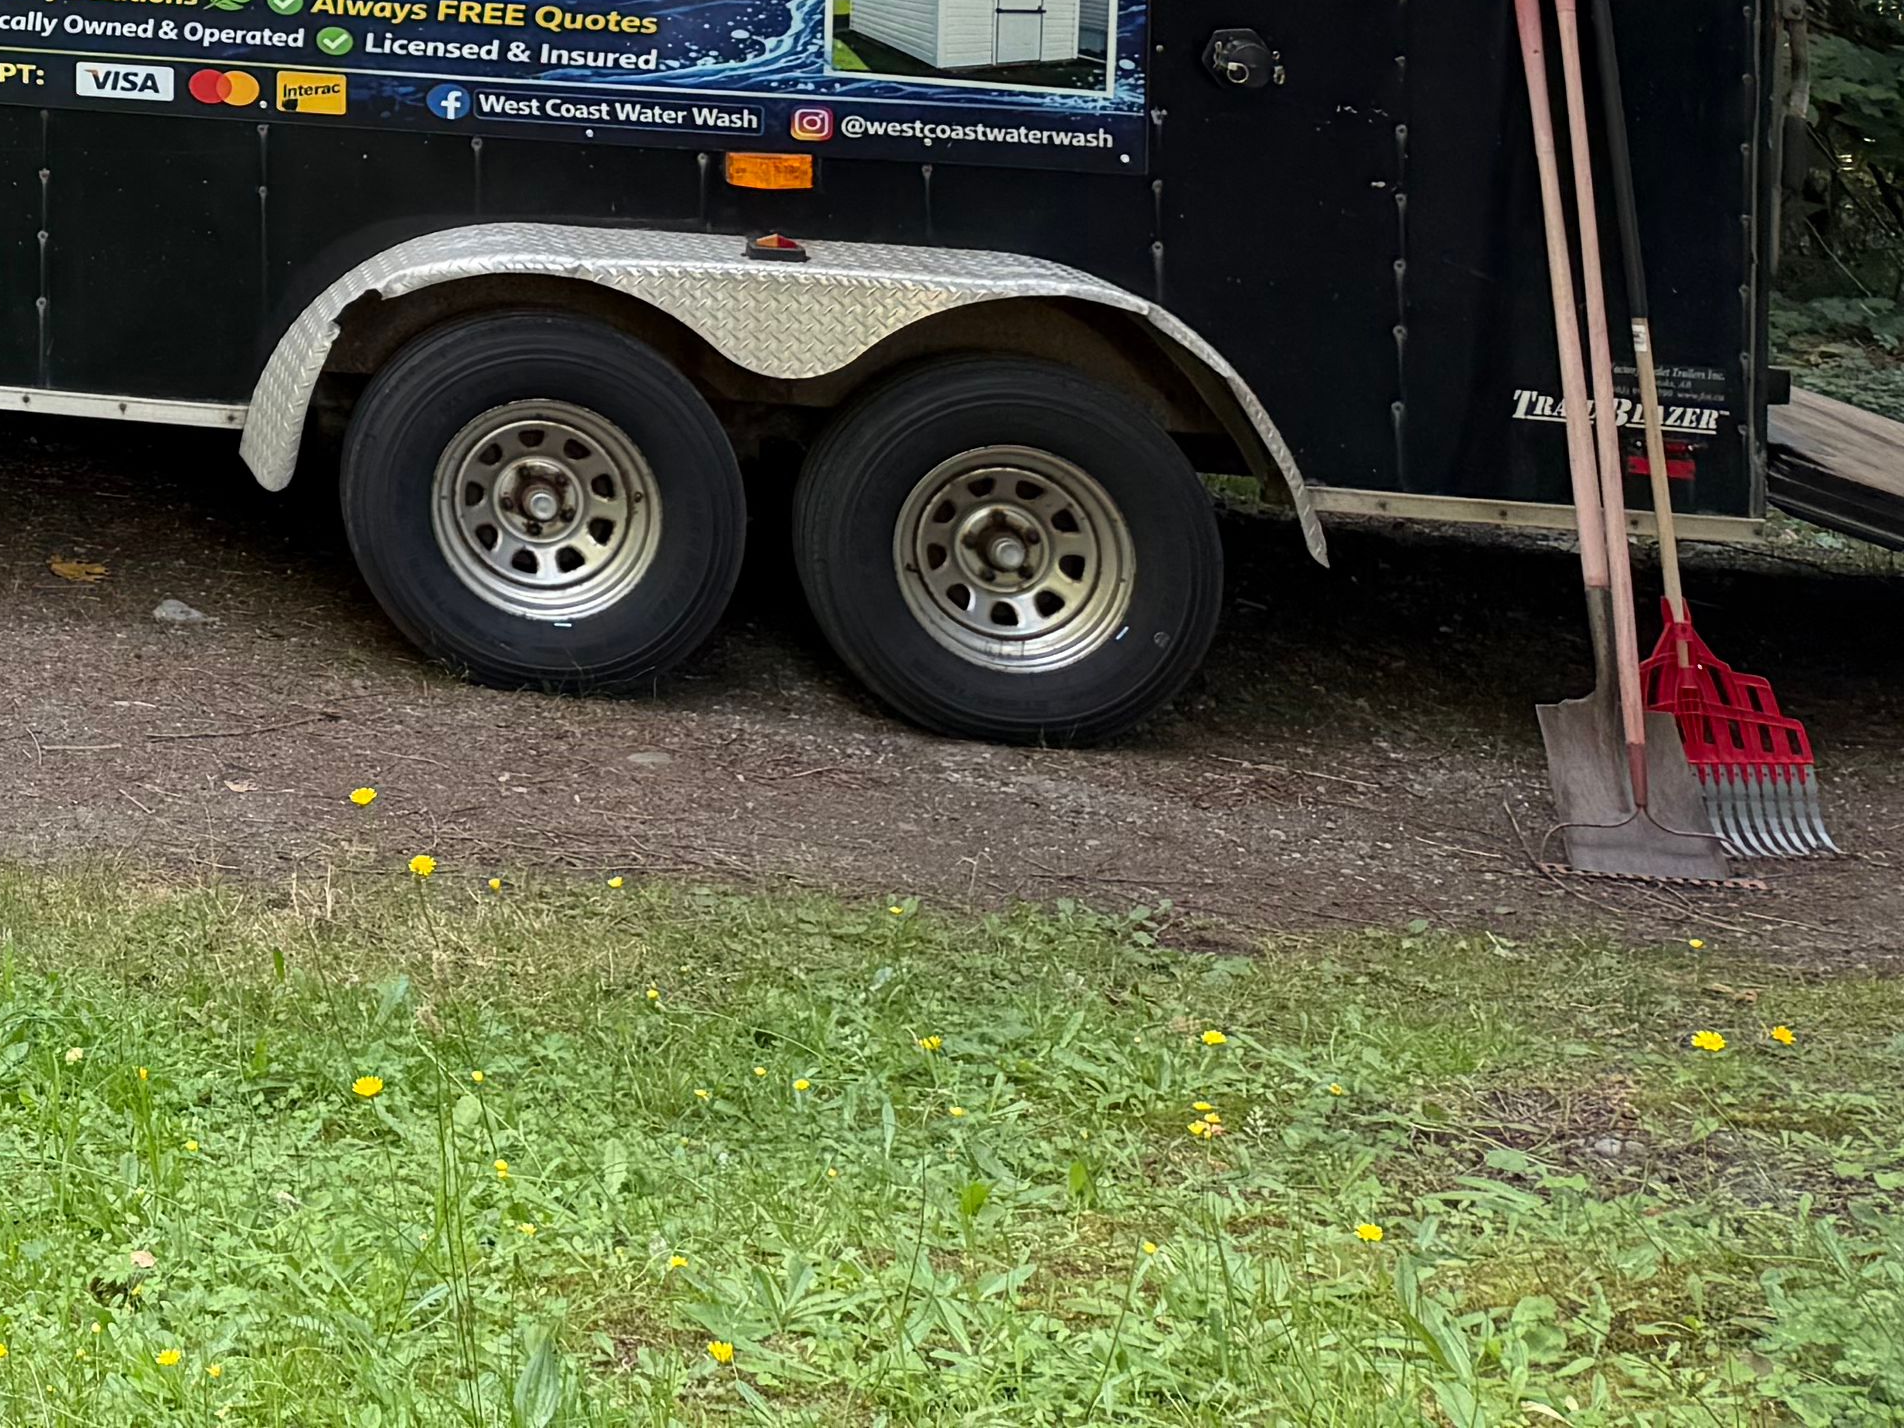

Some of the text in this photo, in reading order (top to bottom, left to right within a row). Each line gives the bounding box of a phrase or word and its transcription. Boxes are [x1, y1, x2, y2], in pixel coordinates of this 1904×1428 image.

[64, 14, 154, 39] Owned
[158, 20, 179, 40] &
[184, 21, 305, 48] Operated
[437, 0, 526, 27] FREE
[534, 5, 658, 34] Quotes
[365, 33, 657, 70] Licensed & Insured
[84, 69, 160, 94] VISA
[283, 83, 341, 99] Interac
[479, 94, 758, 130] West Coast Water Wash
[841, 115, 1114, 149] @westcoastwaterwash
